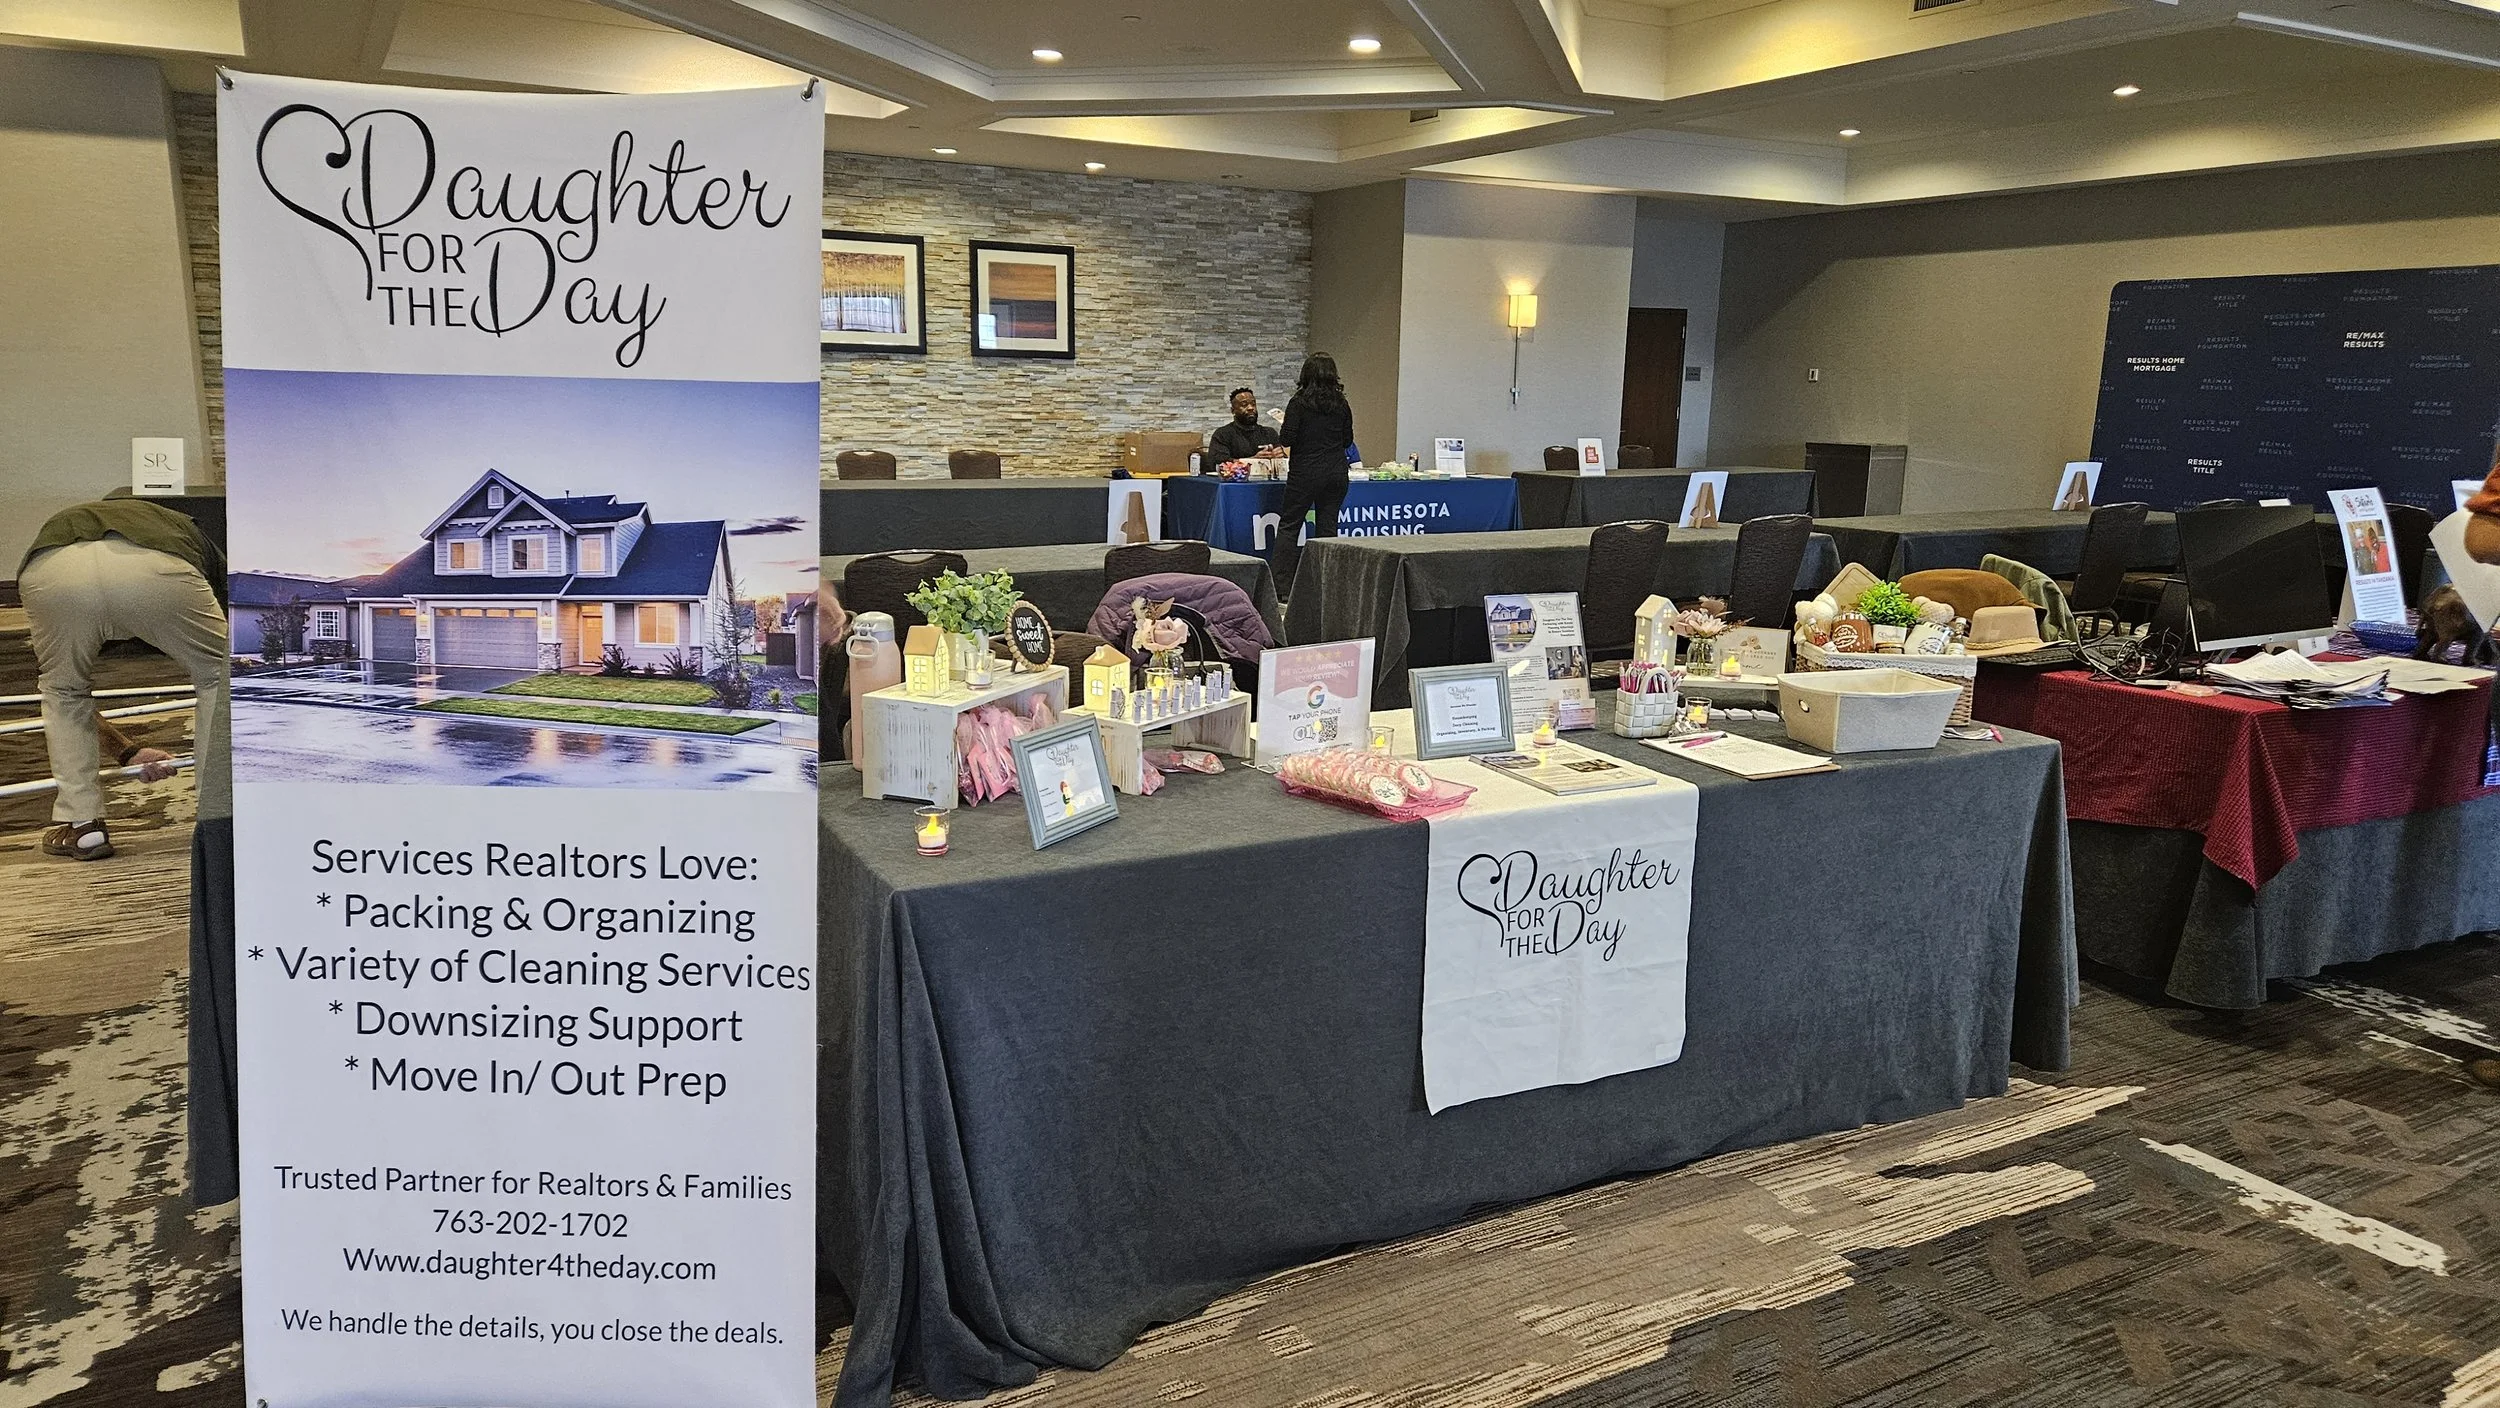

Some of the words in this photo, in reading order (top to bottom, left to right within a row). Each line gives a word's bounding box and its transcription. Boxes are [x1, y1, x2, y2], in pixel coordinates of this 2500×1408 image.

[342, 108, 792, 264] Daughter
[377, 232, 466, 274] FOR
[376, 286, 467, 327] THE
[470, 227, 667, 368] Day
[2343, 340, 2386, 349] RESULTS
[2346, 331, 2385, 340] RE/MAX
[144, 453, 177, 471] SR
[2187, 458, 2223, 467] RESULTS
[2193, 466, 2216, 474] TITLE
[1338, 502, 1450, 523] MINNESOTA
[1015, 617, 1035, 629] HOME
[1025, 641, 1045, 653] HOME
[1317, 660, 1355, 671] APPRECIATE
[1288, 711, 1300, 721] TAP
[1302, 710, 1319, 719] YOUR
[1320, 707, 1342, 718] PHONE
[312, 840, 472, 876] Services
[487, 843, 646, 879] Realtors
[660, 846, 757, 880] Love:
[1494, 848, 1681, 915] Daughter
[346, 894, 493, 938] Packing
[503, 897, 532, 930] &
[543, 898, 755, 942] Organizing
[1505, 934, 1543, 958] THE
[1544, 900, 1627, 962] Day
[1507, 907, 1545, 932] FOR
[276, 947, 420, 989] Variety
[431, 949, 469, 982] of
[479, 950, 648, 993] Cleaning
[658, 953, 810, 990] Services
[357, 1002, 578, 1047] Downsizing
[588, 1006, 742, 1048] Support
[372, 1058, 477, 1092] Move
[491, 1060, 542, 1097] In/
[551, 1062, 625, 1096] Out
[638, 1063, 726, 1104] Prep
[274, 1166, 376, 1190] Trusted
[386, 1168, 484, 1194] Partner
[492, 1170, 530, 1194] for
[539, 1172, 648, 1197] Realtors
[656, 1174, 676, 1197] &
[685, 1174, 791, 1200] Families
[433, 1209, 627, 1237] 763-202-1702
[343, 1248, 715, 1284] Www.daughter4theday.com
[281, 1309, 322, 1331] We
[330, 1310, 407, 1335] handle
[414, 1313, 452, 1336] the
[459, 1315, 544, 1342] details,
[551, 1324, 594, 1344] you
[601, 1319, 662, 1341] close
[669, 1320, 708, 1342] the
[715, 1321, 782, 1344] deals.
